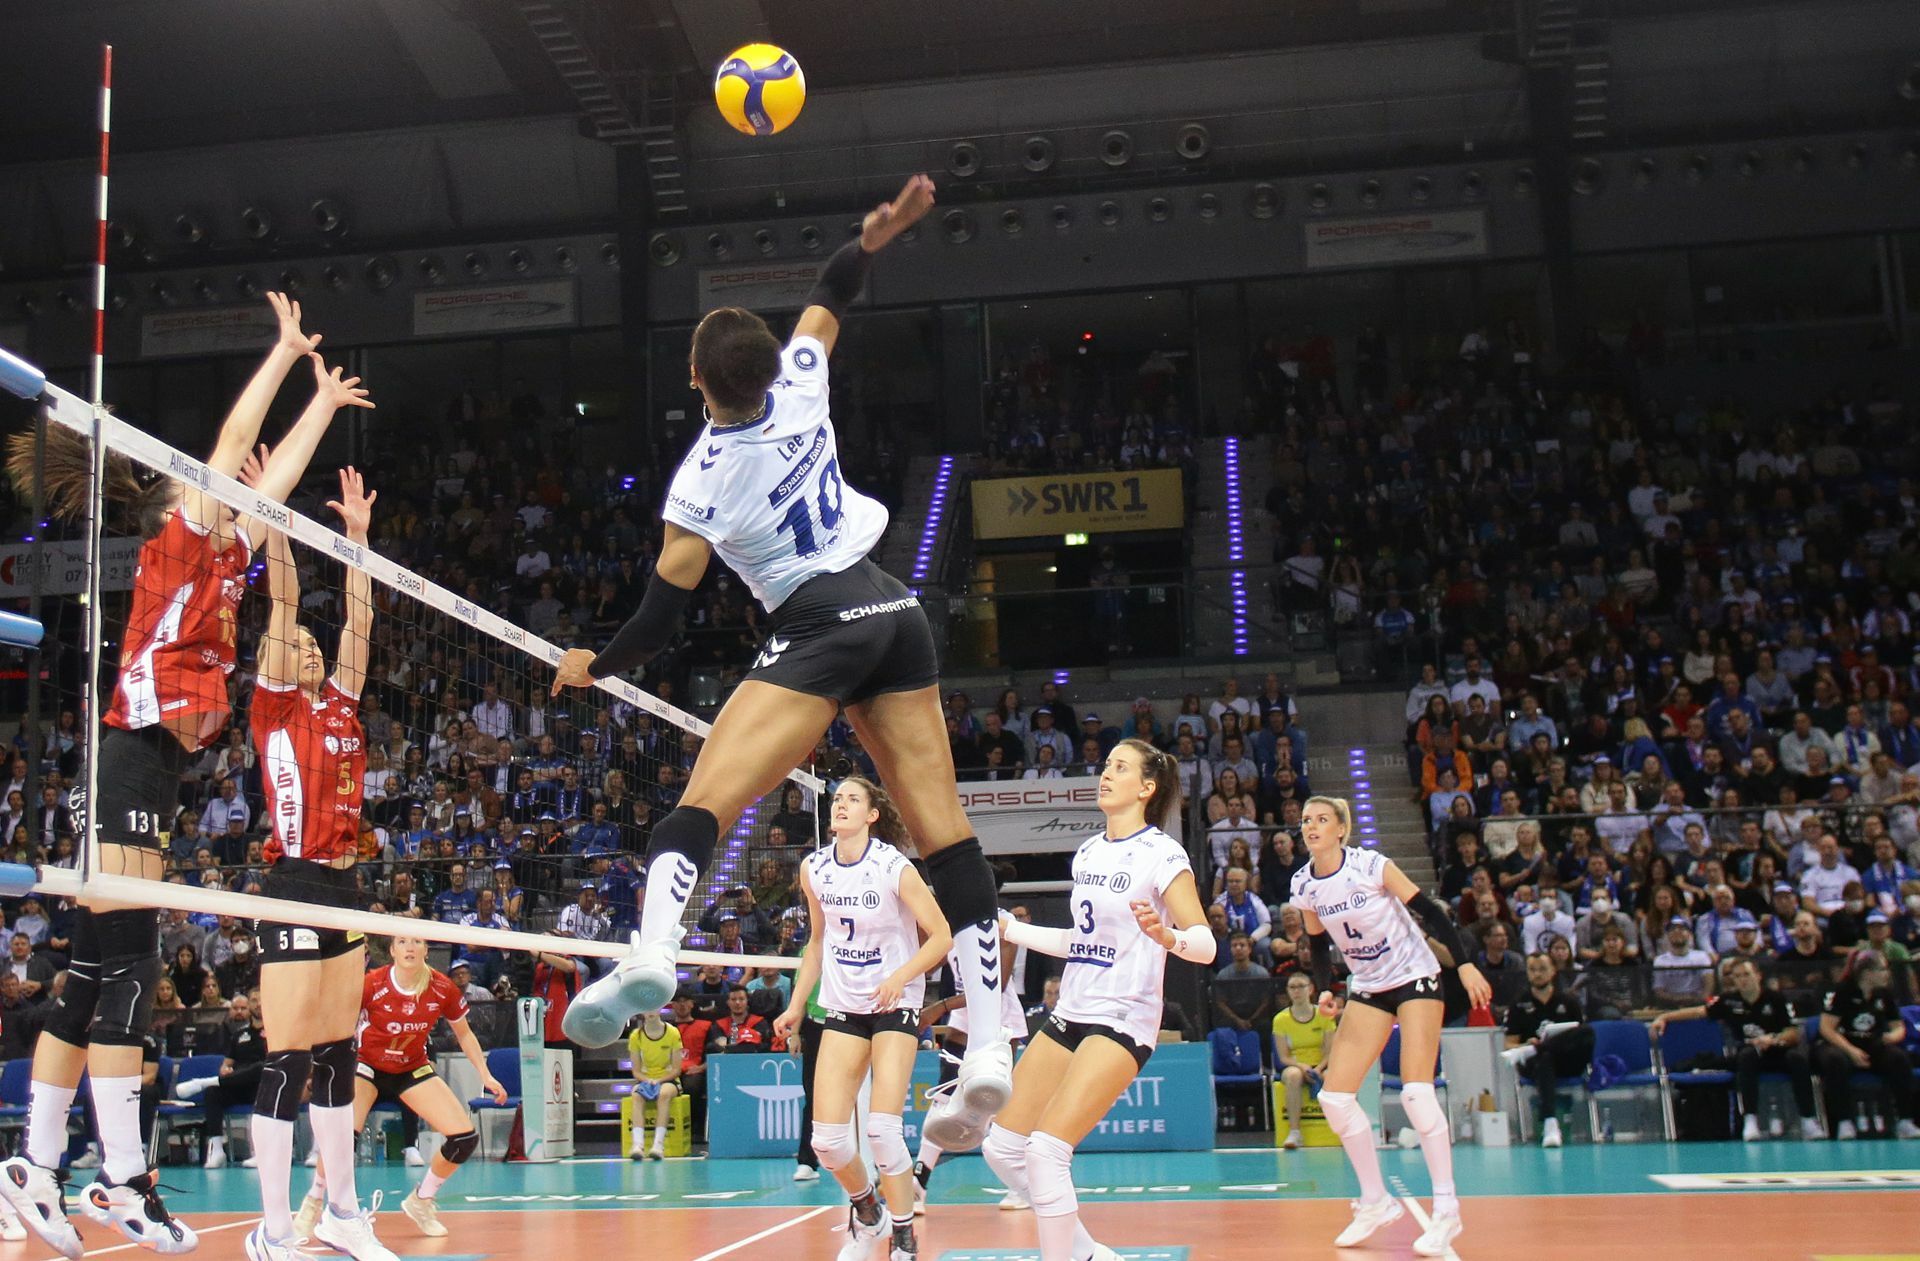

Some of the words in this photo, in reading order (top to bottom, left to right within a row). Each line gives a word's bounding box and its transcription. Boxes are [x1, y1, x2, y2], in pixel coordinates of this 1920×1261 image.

[710, 267, 817, 285] PORSCHE
[777, 434, 805, 463] Lee
[169, 452, 199, 482] Allianz
[777, 435, 827, 497] Sparda-Bank
[256, 500, 288, 526] SCHARR
[776, 456, 842, 557] 10
[333, 536, 355, 561] Allianz
[396, 572, 421, 595] SCHARR
[839, 596, 921, 622] SCHARRman
[127, 809, 150, 834] 13
[820, 892, 859, 906] Allianz
[839, 917, 856, 941] 7
[1079, 899, 1095, 935] 3
[279, 930, 289, 950] 5
[1342, 921, 1363, 940] 4
[1415, 978, 1425, 993] 4
[403, 1022, 428, 1032] EWP
[902, 1010, 910, 1025] 7
[1096, 1118, 1166, 1135] TIEFE
